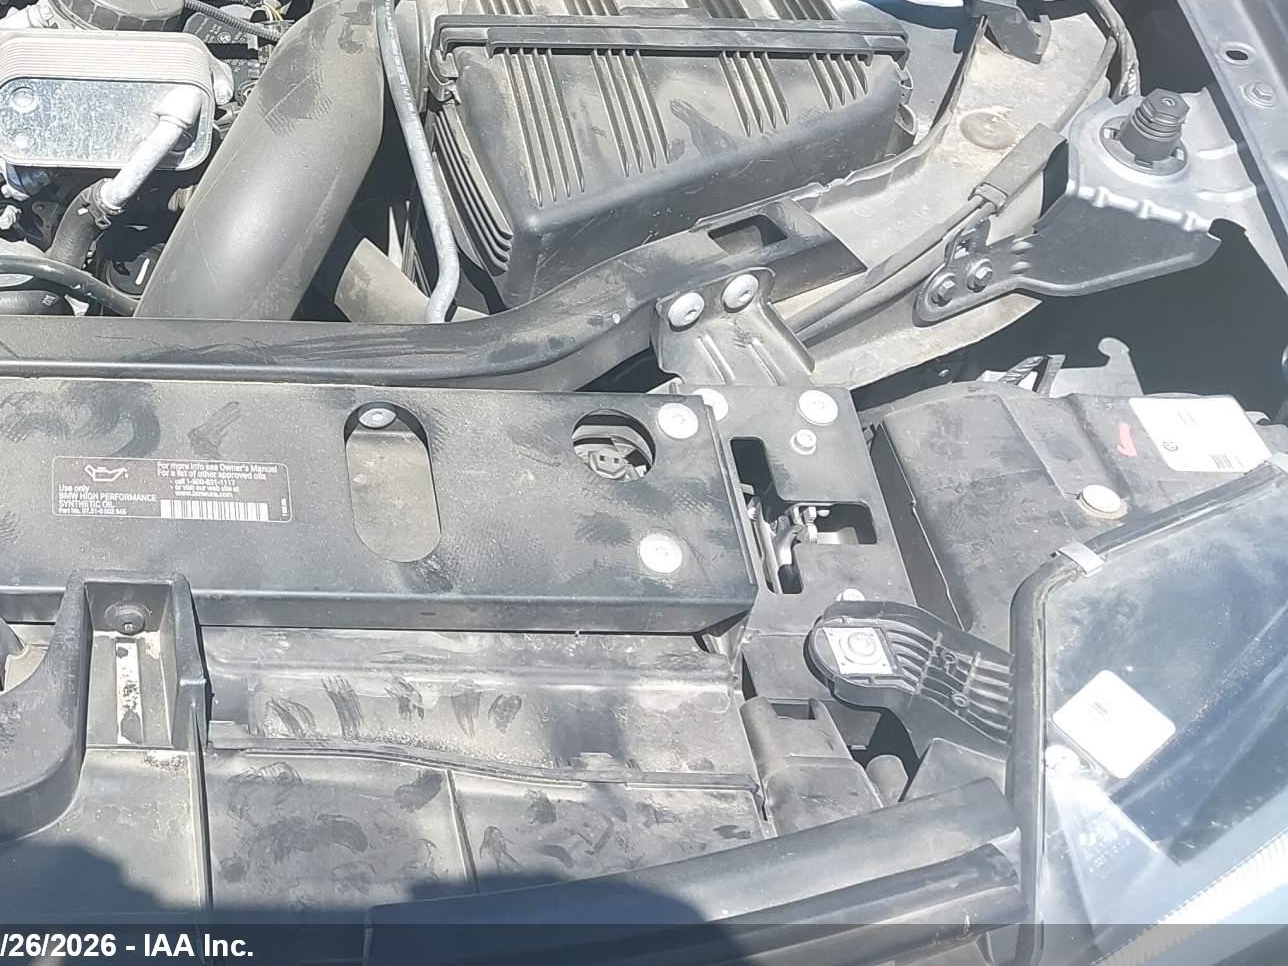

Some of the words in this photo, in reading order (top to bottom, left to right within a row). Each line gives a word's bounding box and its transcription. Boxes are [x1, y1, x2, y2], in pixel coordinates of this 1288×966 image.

[191, 463, 204, 471] info
[219, 464, 249, 472] Owner's
[250, 465, 278, 473] Manual
[218, 471, 252, 479] approved
[58, 484, 72, 492] Use
[74, 485, 90, 493] only
[58, 492, 78, 500] BMW
[80, 492, 99, 500] HIGH
[100, 493, 157, 502] PERFORMANCE
[58, 500, 101, 508] SYNTHETIC
